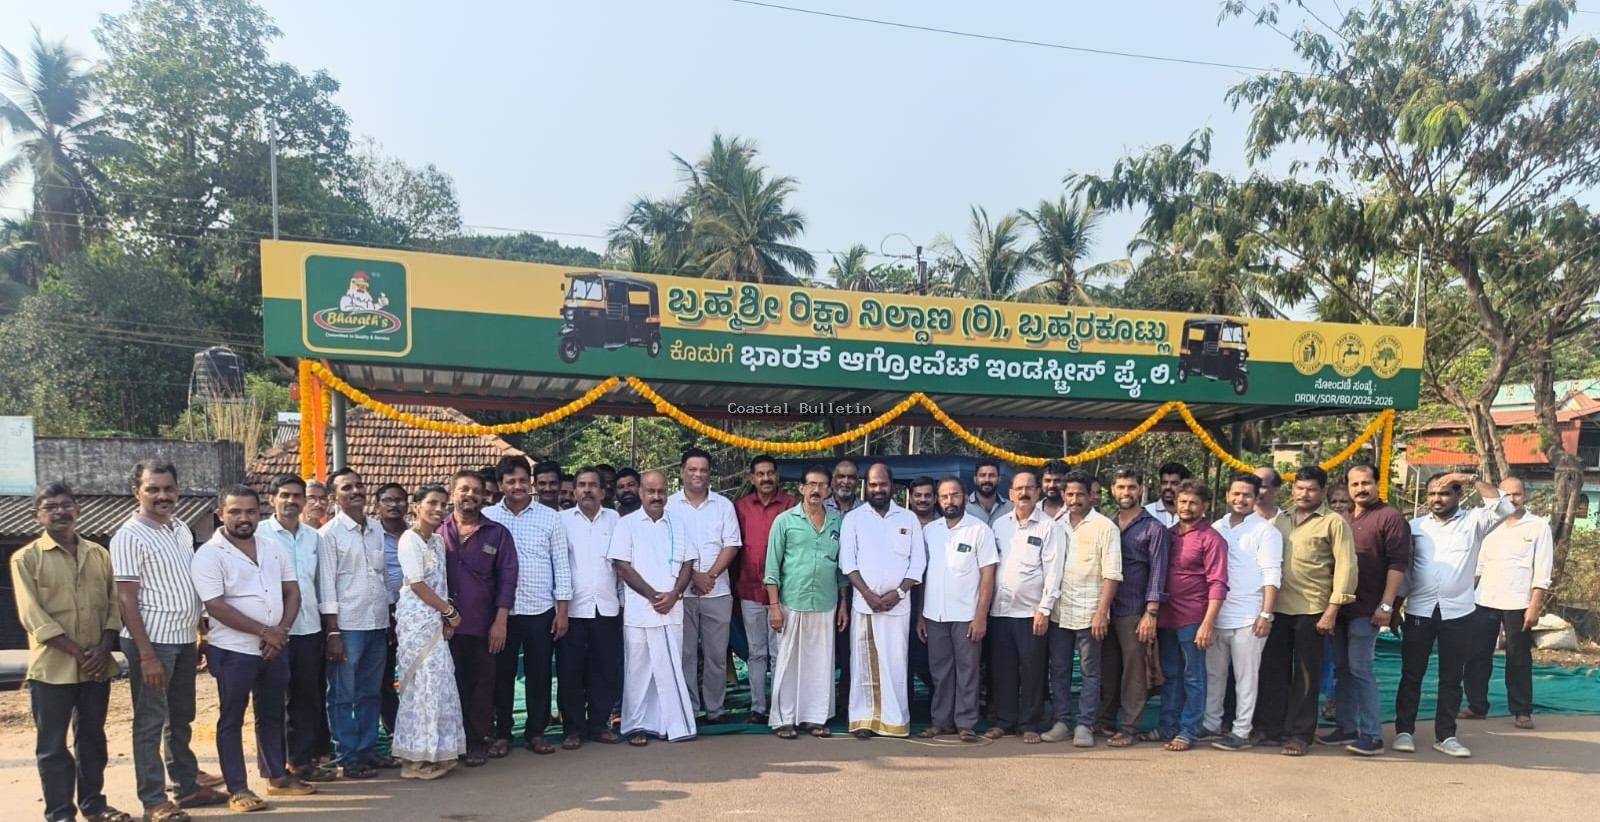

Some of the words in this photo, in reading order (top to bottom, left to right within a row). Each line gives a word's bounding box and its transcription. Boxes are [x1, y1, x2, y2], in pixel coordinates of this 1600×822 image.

[327, 312, 389, 328] Bharath's
[668, 284, 780, 333] ಬ್ರಹ್ಮಶ್ರೀ
[790, 290, 850, 336] ರಿಕ್ಷಾ
[858, 298, 954, 345] ನಿಲ್ದಾಣ
[1018, 310, 1172, 355] ಬ್ರಹ್ಮರಕೂಟ್ಲು
[670, 339, 733, 364] ಕೊಡುಗೆ
[740, 344, 831, 372] ಭಾರತ್
[838, 346, 979, 381] ಆಗ್ರೋವೆಟ್
